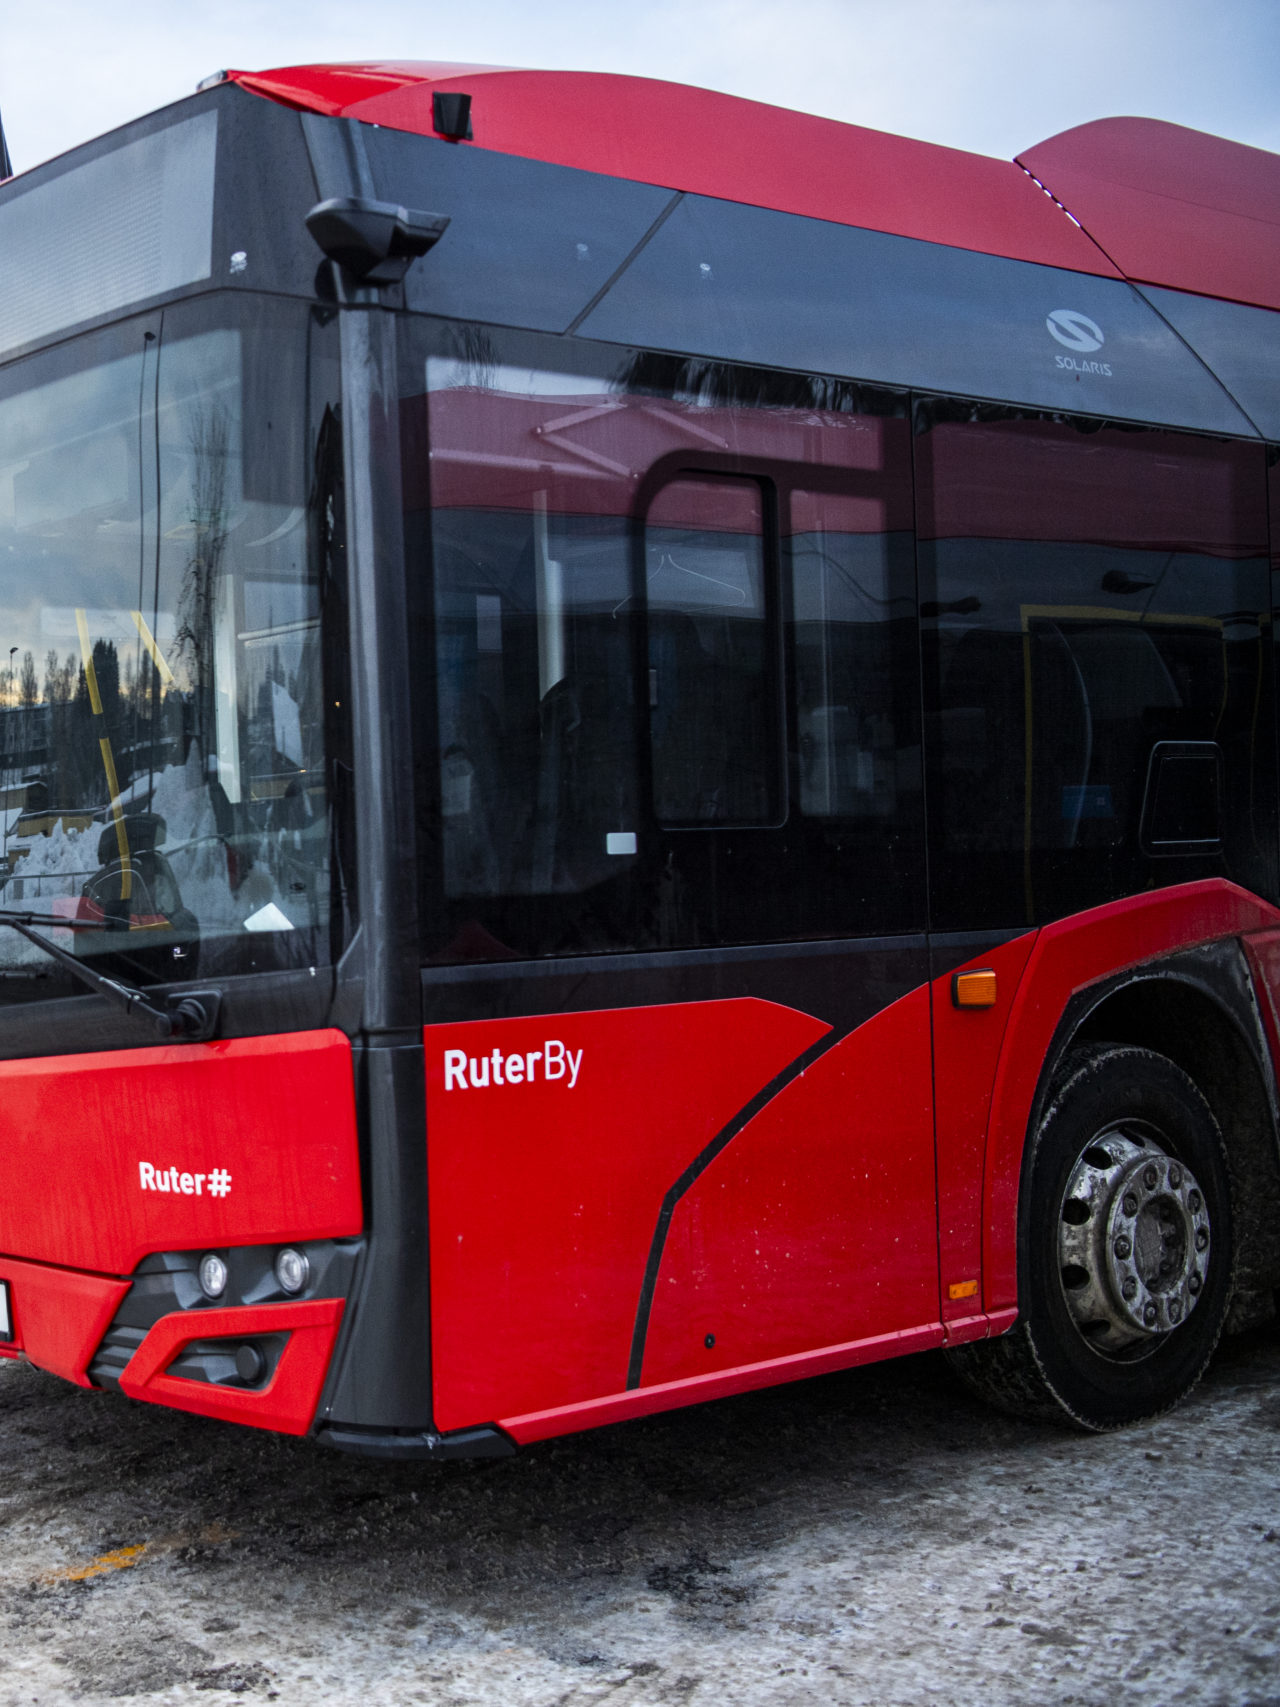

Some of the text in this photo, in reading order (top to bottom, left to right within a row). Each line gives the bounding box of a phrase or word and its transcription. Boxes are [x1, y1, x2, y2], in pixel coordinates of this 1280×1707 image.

[1055, 355, 1113, 377] SOLARIS
[444, 1040, 584, 1091] RuterBy
[139, 1161, 232, 1198] Ruter#
